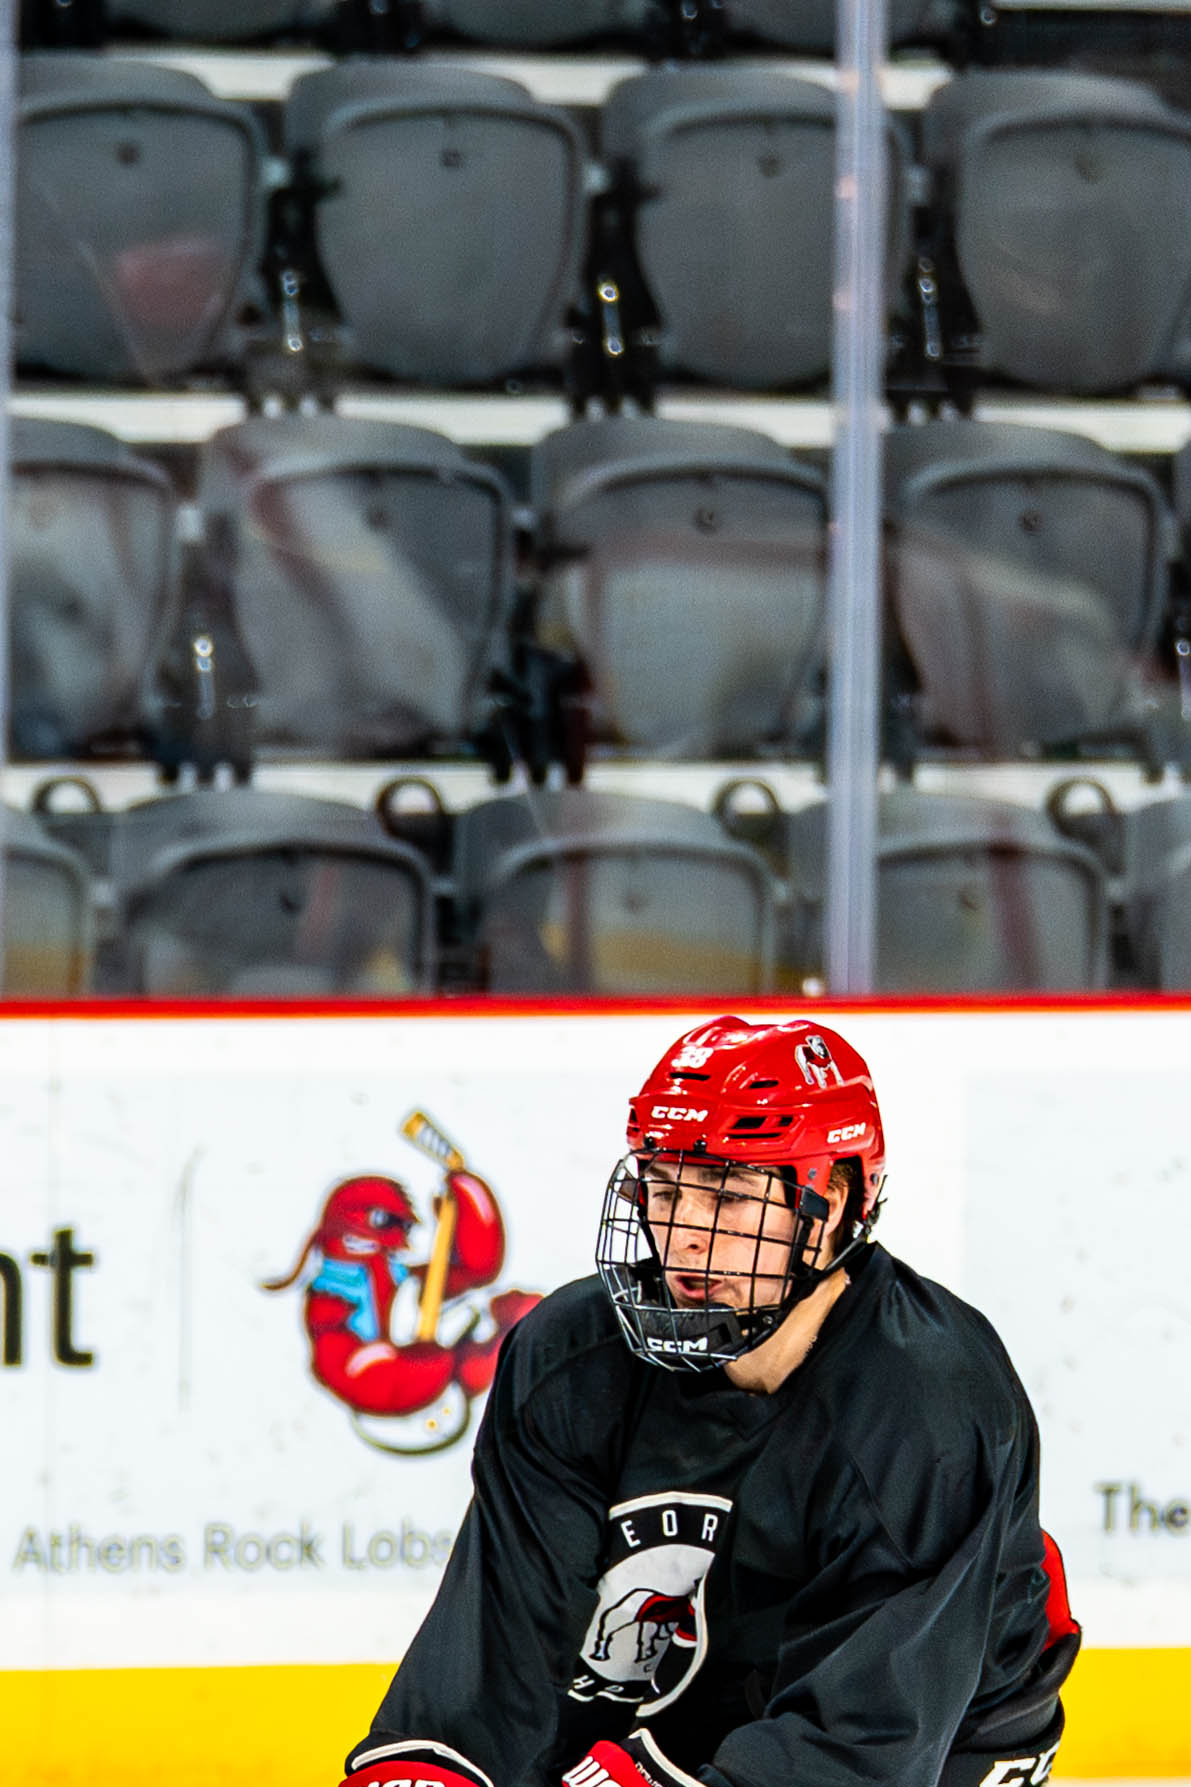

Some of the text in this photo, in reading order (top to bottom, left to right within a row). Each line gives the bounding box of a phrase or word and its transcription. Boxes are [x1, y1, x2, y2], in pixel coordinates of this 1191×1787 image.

[650, 1106, 708, 1122] CCM
[827, 1122, 866, 1144] CCM
[647, 1337, 708, 1352] CCM
[1094, 1482, 1191, 1532] The
[13, 1525, 185, 1572] Athens
[205, 1521, 322, 1571] Rock
